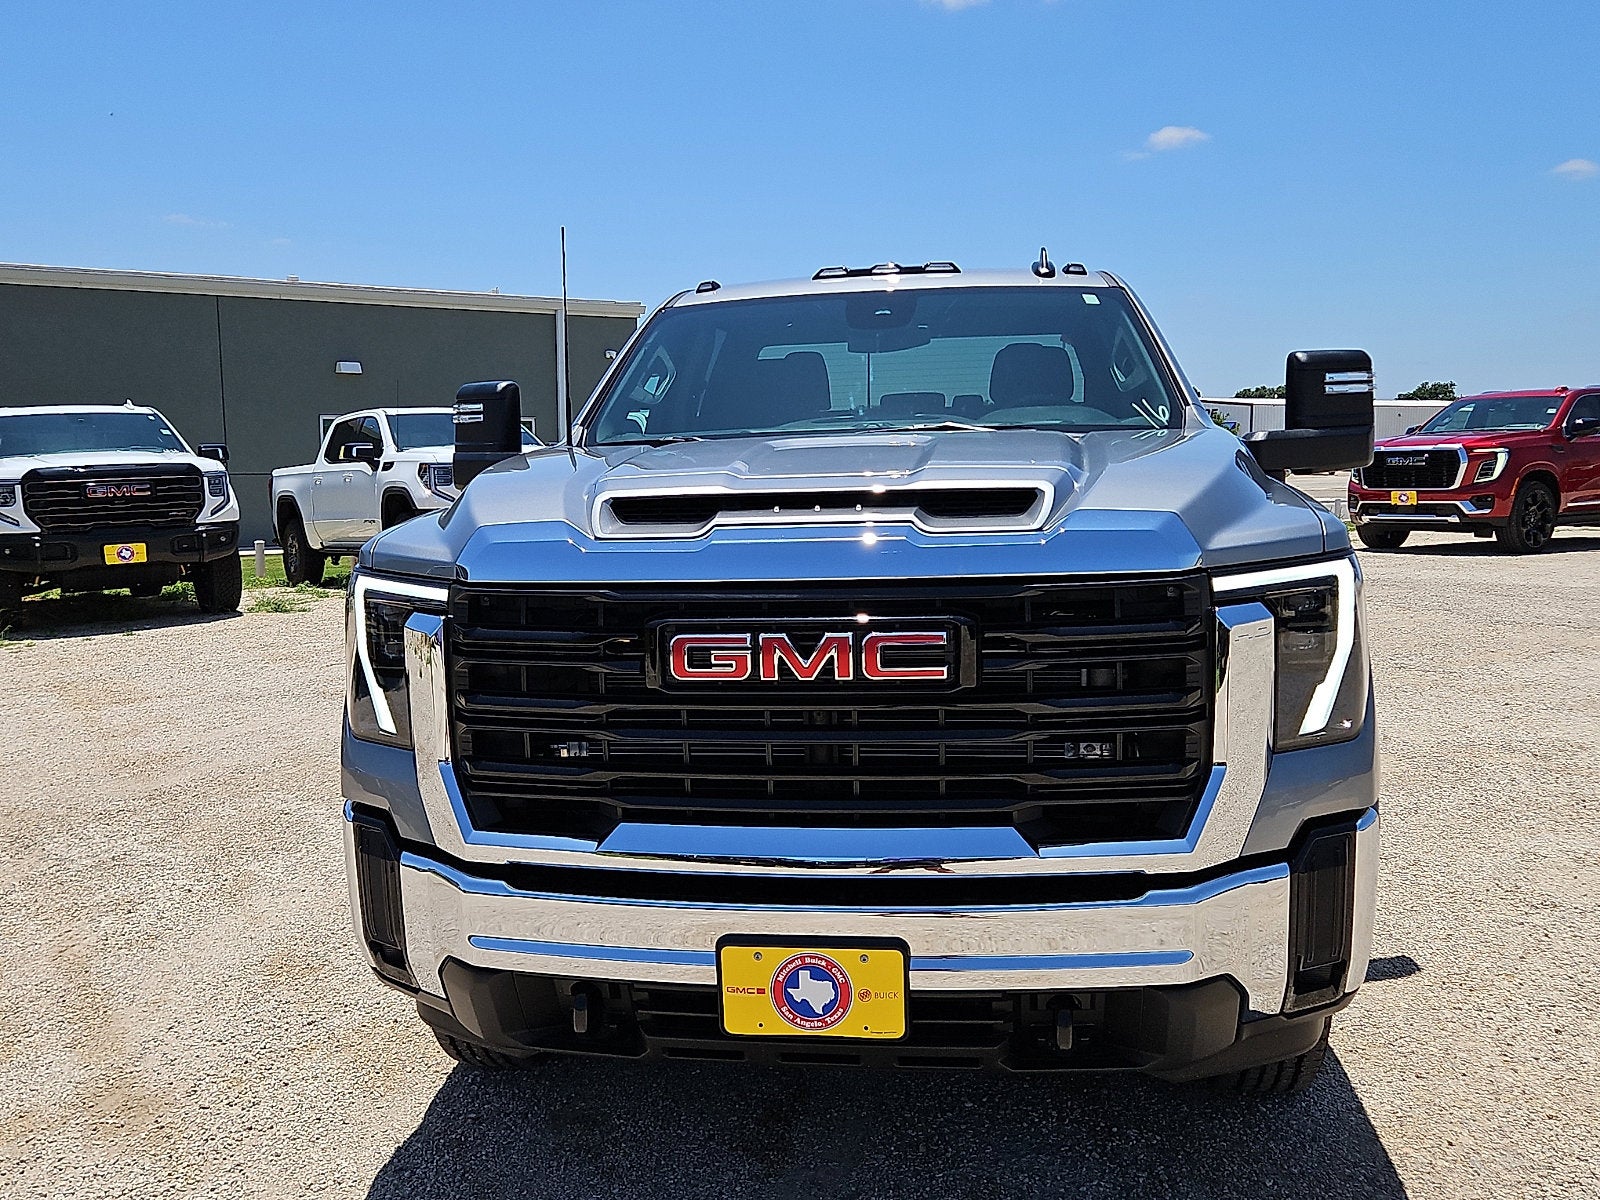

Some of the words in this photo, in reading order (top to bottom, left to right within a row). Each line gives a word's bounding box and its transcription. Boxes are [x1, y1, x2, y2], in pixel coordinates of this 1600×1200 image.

[86, 484, 151, 498] GMC
[670, 631, 948, 681] GMC
[776, 959, 802, 983] Mitchell
[804, 956, 828, 967] Buick
[831, 966, 846, 984] GMC
[726, 985, 756, 995] GMC
[874, 991, 899, 1000] BUICK
[780, 1005, 795, 1020] San
[824, 1007, 844, 1025] Texas
